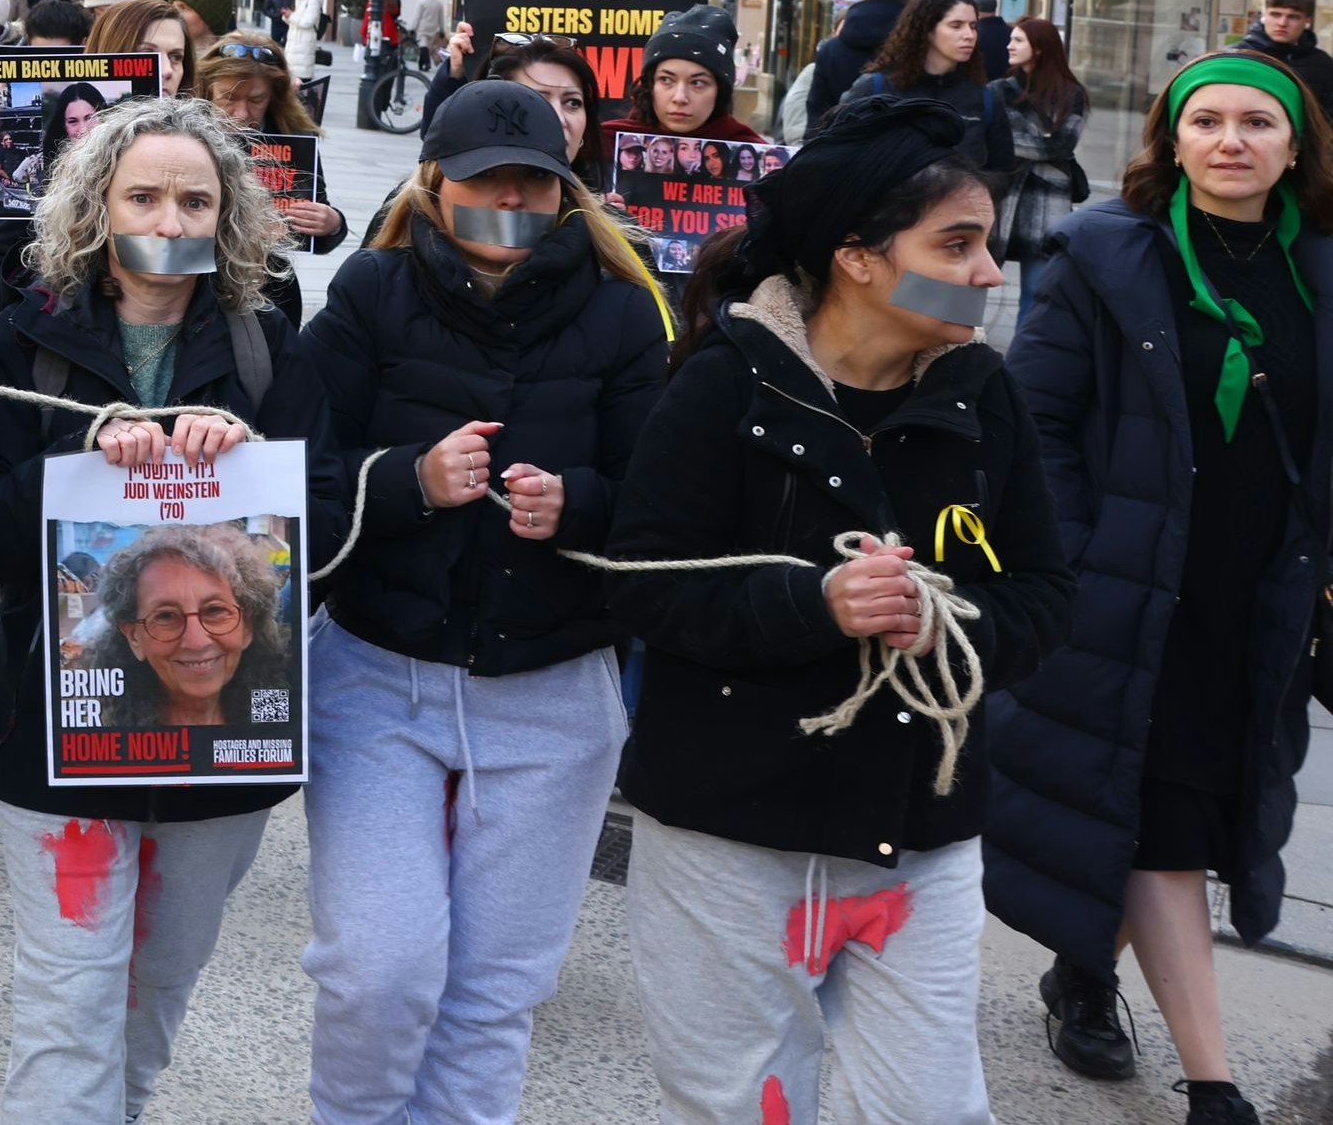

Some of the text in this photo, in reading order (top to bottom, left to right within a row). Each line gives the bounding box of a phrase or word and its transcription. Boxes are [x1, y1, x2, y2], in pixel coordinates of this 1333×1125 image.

[505, 7, 665, 36] SISTERS HOME
[21, 60, 61, 78] BACK
[64, 59, 109, 78] HOME
[113, 59, 154, 78] NOW!
[663, 181, 723, 205] WE ARE
[670, 209, 710, 235] YOU
[123, 481, 220, 500] JUDI WEINSTEIN
[160, 501, 184, 520] (70)
[60, 668, 125, 697] BRING
[61, 699, 102, 728] HER
[61, 727, 190, 761] HOME NOW!
[213, 739, 293, 750] HOSTAGES AND MISSING
[213, 748, 293, 763] FAMILIES FORUM
